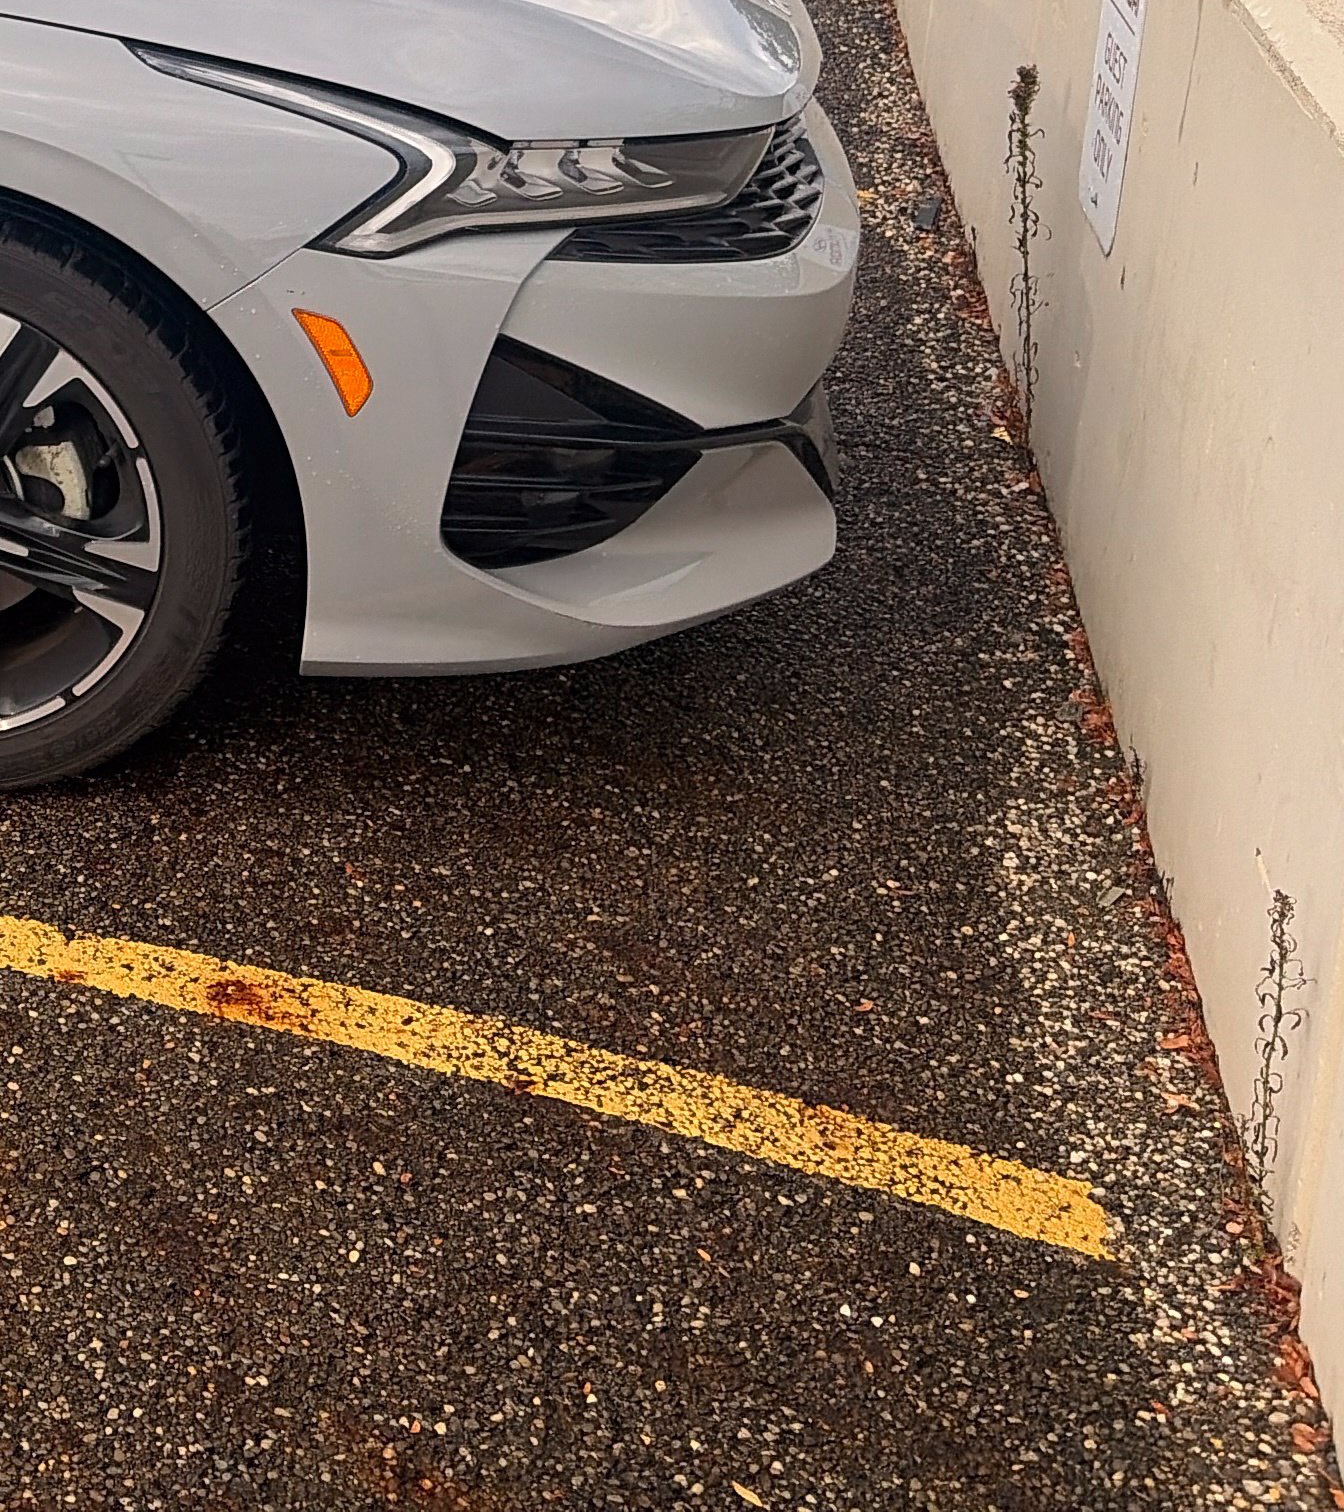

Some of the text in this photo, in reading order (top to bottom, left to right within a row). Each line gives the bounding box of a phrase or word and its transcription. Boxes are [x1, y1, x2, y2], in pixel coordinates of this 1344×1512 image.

[1104, 31, 1128, 90] GUEST
[1094, 73, 1124, 145] PARKING
[1092, 129, 1113, 184] ONLY
